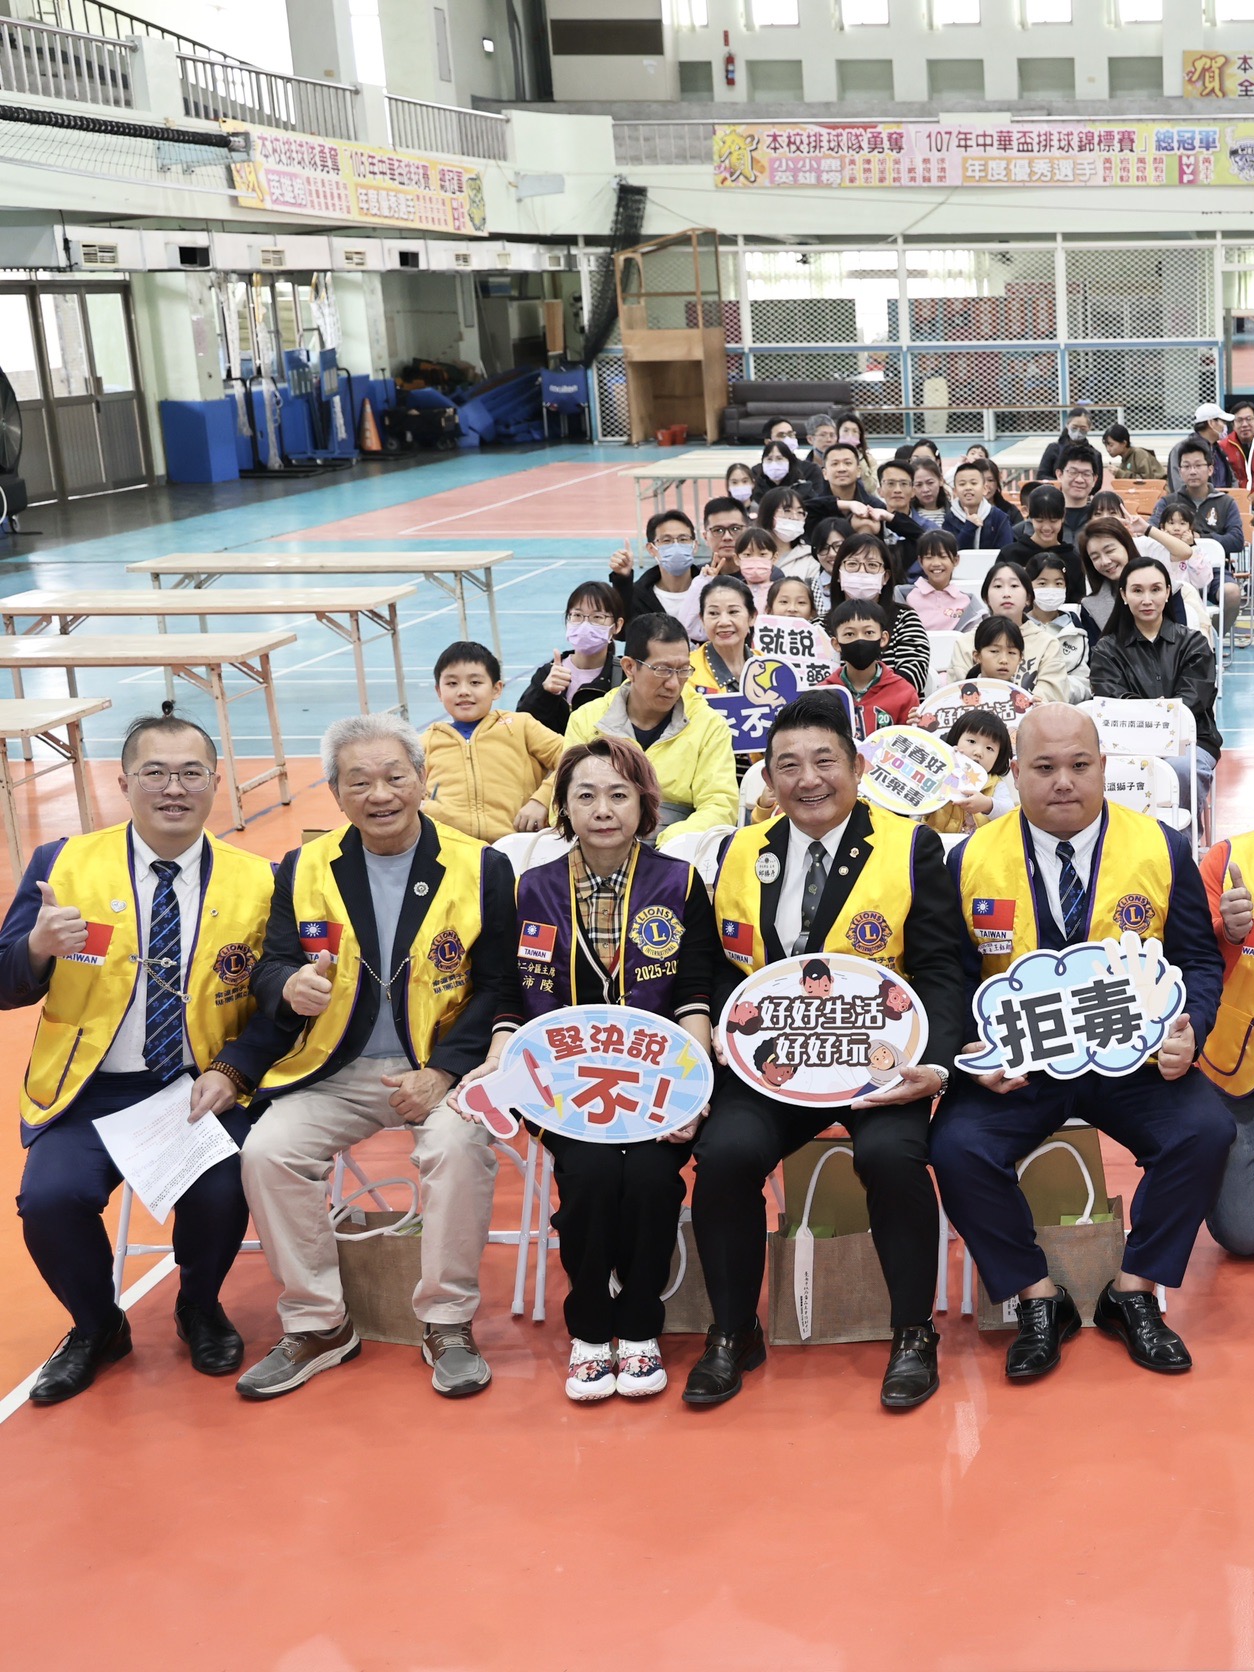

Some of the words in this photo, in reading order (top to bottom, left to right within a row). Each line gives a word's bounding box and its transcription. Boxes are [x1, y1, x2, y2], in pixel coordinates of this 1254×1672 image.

[759, 626, 815, 657] 就說
[877, 715, 890, 724] 20
[889, 734, 949, 775] 青春好
[869, 764, 927, 807] 不藥毒
[1104, 782, 1146, 792] 瀛獅子會
[1121, 895, 1147, 907] LIONS
[639, 906, 671, 922] LIONS
[855, 912, 882, 923] LIONS
[650, 922, 667, 942] L
[863, 924, 877, 940] L
[980, 930, 1007, 939] TAIWAN
[524, 947, 547, 959] TAIWAN
[728, 951, 749, 964] TAIWAN
[760, 996, 886, 1030] 好好生活
[995, 978, 1143, 1069] 拒毒
[545, 1023, 669, 1066] 堅決說
[775, 1033, 871, 1067] 好好玩
